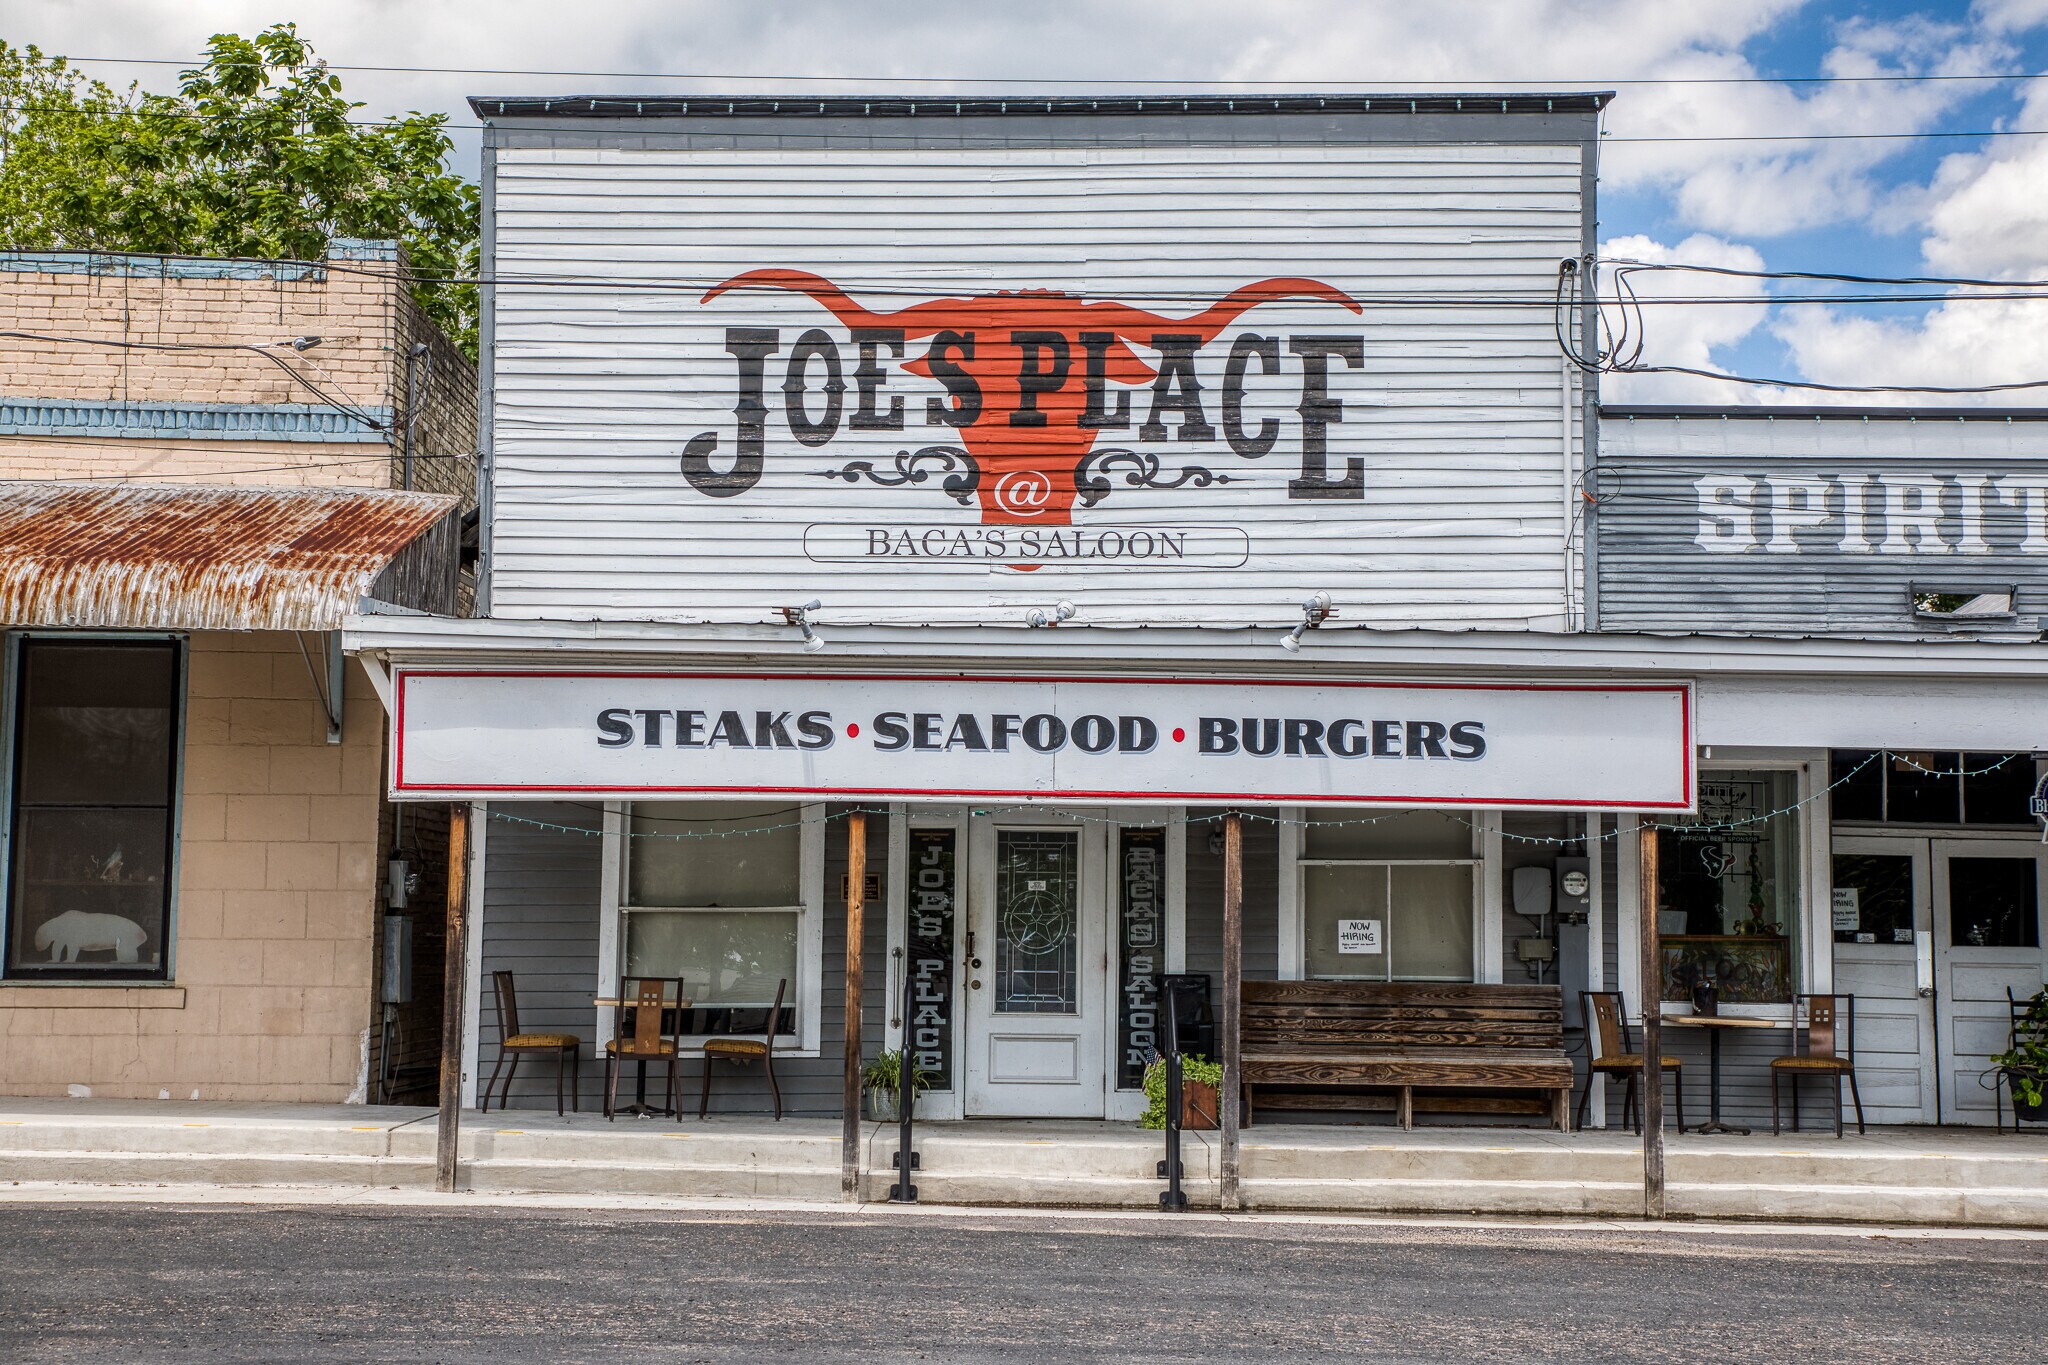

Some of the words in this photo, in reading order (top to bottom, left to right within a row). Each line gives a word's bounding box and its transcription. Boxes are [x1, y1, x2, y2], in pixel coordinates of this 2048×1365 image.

[681, 328, 983, 497] JOES
[1009, 330, 1365, 499] PLACE
[994, 470, 1051, 516] @
[865, 529, 1006, 557] BACA'S
[1019, 530, 1187, 559] SALOON
[597, 708, 835, 751] STEAKS
[873, 711, 1159, 755] SEAFOOD
[1199, 716, 1487, 762] BURGERS
[917, 846, 953, 937] JOE'S
[1340, 932, 1374, 942] HIRING
[1349, 921, 1371, 931] NOW
[914, 959, 947, 1071] PLACE
[1125, 957, 1159, 1066] SALOON
